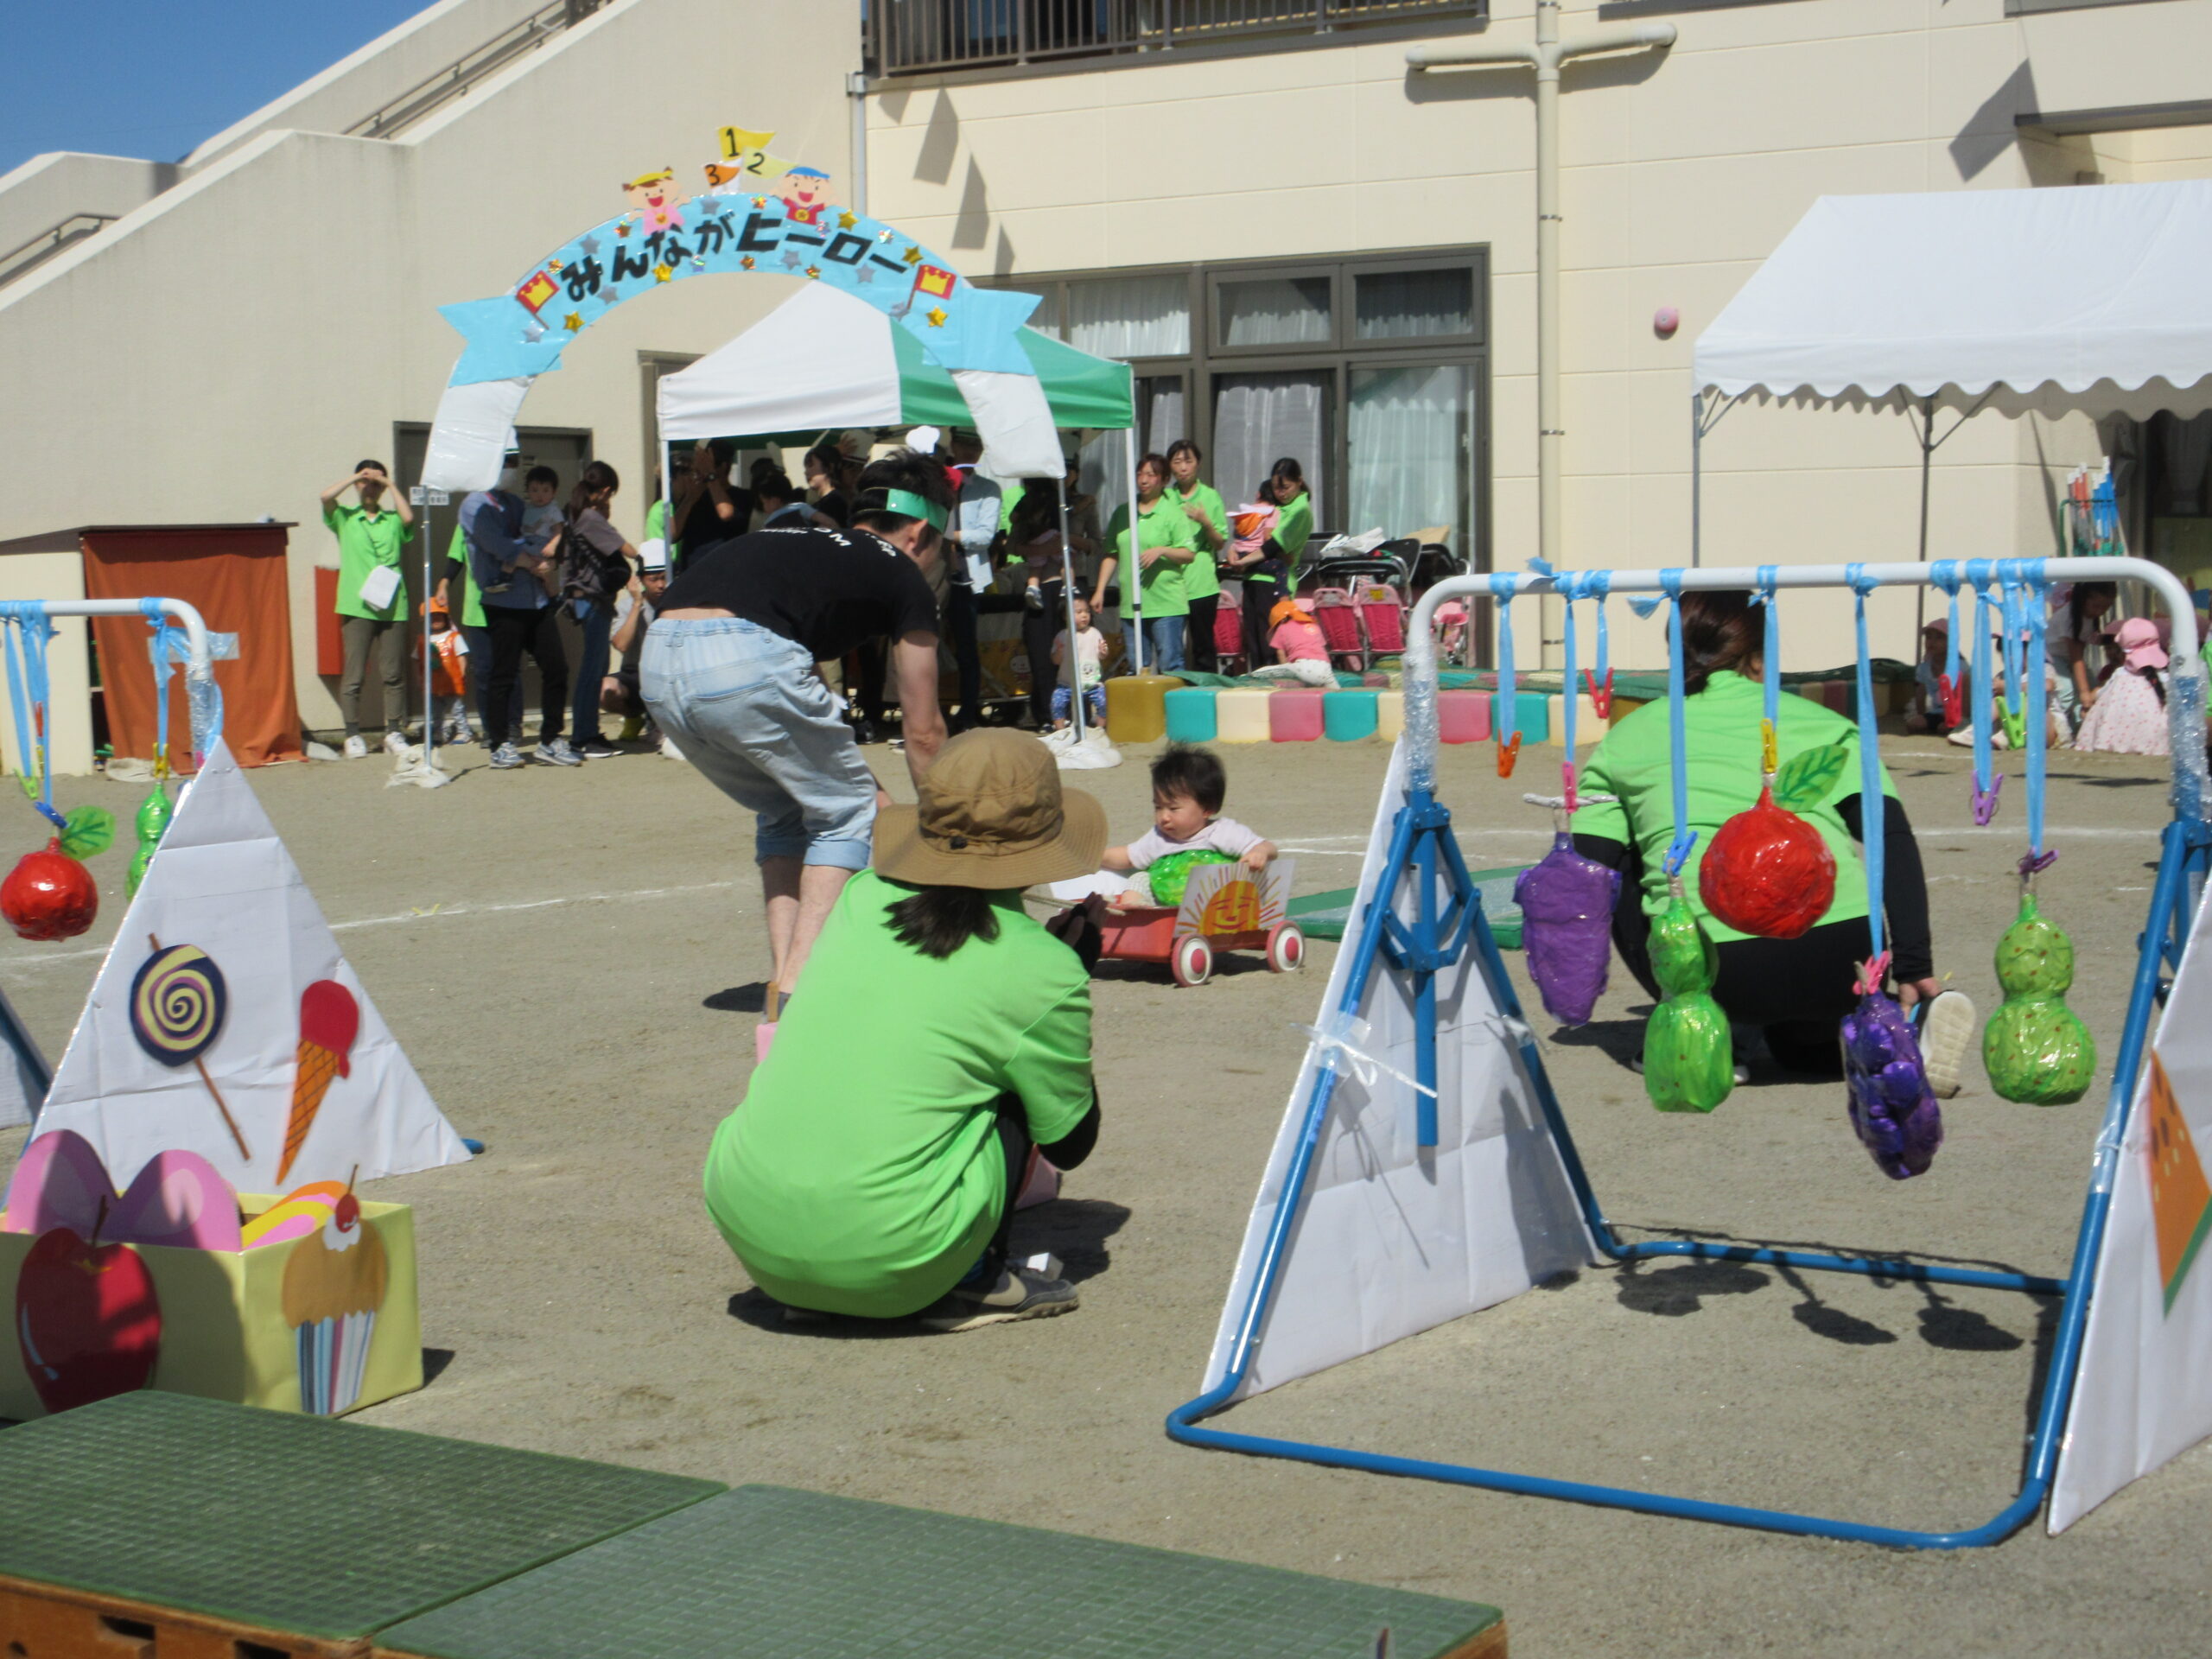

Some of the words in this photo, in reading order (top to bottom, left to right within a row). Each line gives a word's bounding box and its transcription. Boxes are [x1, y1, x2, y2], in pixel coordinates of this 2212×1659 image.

[726, 128, 740, 157] 1
[704, 164, 721, 187] 3
[747, 152, 765, 175] 2
[560, 210, 907, 302] みんながヒーロー
